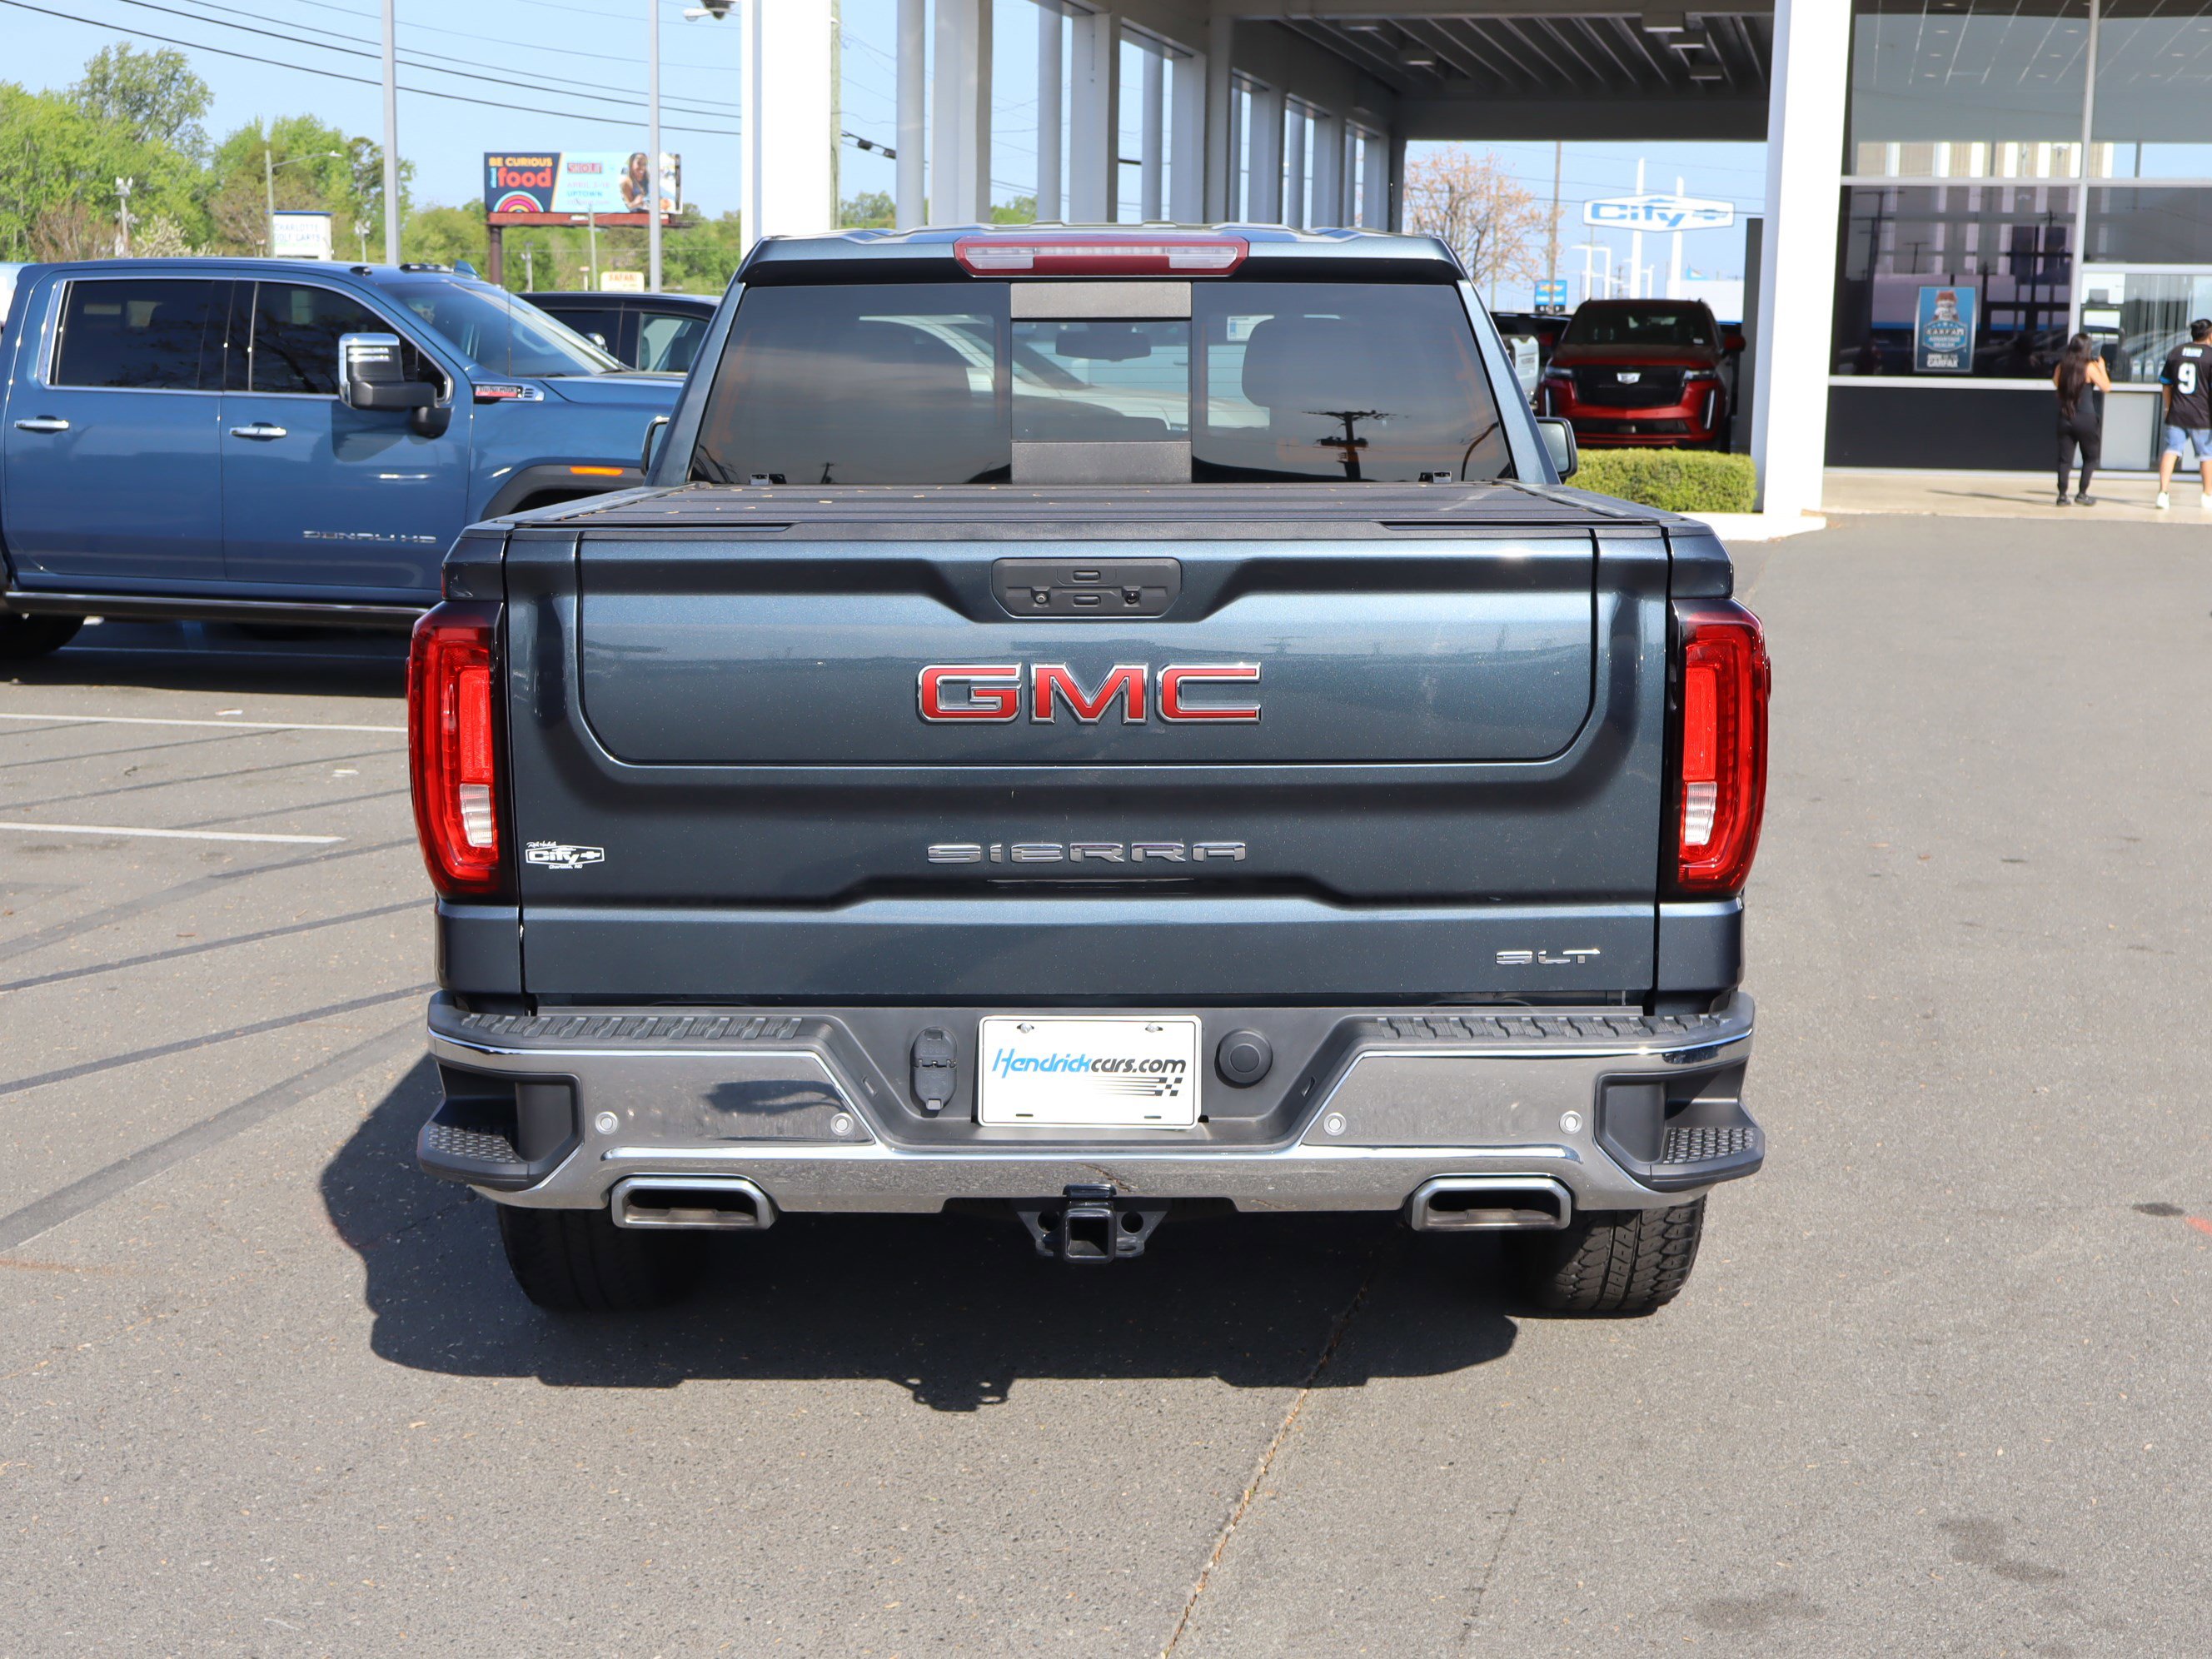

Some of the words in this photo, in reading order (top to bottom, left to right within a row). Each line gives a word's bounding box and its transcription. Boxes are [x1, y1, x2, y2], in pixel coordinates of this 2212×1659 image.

[489, 157, 504, 167] BE
[505, 157, 553, 167] CURIOUS
[497, 167, 552, 188] food
[1591, 202, 1686, 227] City
[2178, 361, 2196, 394] 9
[917, 662, 1262, 725] GMC
[528, 849, 580, 864] City
[927, 842, 1247, 863] SIERRA
[1496, 949, 1601, 964] SLT
[992, 1048, 1187, 1079] Hendrickcars.com
